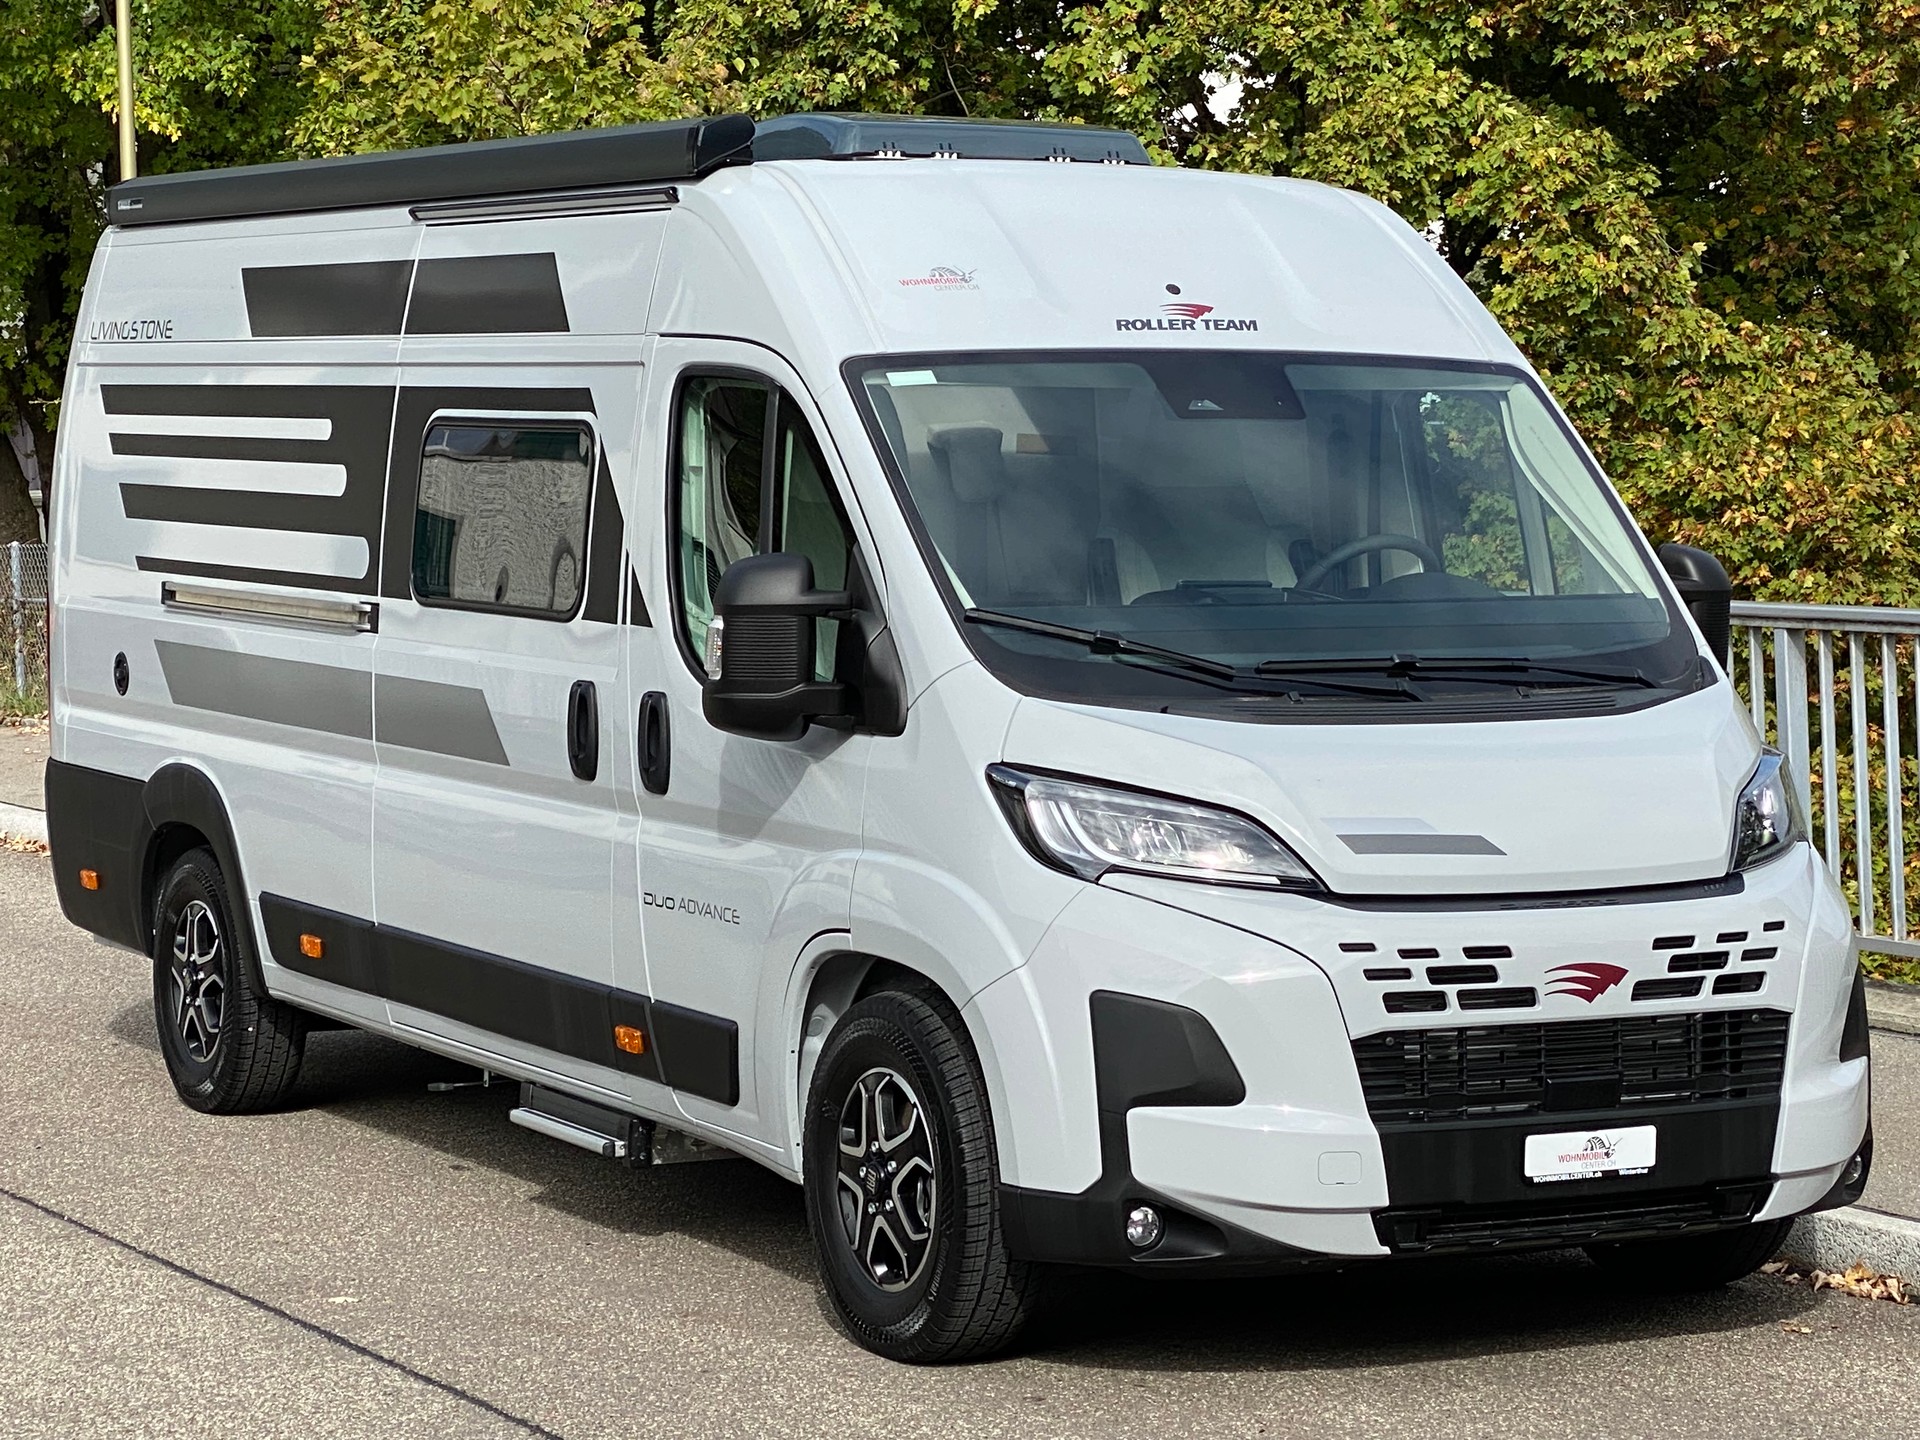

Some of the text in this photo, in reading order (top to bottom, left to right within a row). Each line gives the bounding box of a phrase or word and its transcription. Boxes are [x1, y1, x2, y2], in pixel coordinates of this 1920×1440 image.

[91, 319, 173, 340] LIVINGSTONE
[1116, 318, 1258, 331] ROLLER TEAM
[643, 892, 741, 925] DUO ADVANCE
[1558, 1151, 1605, 1163] WOHNMOBIL
